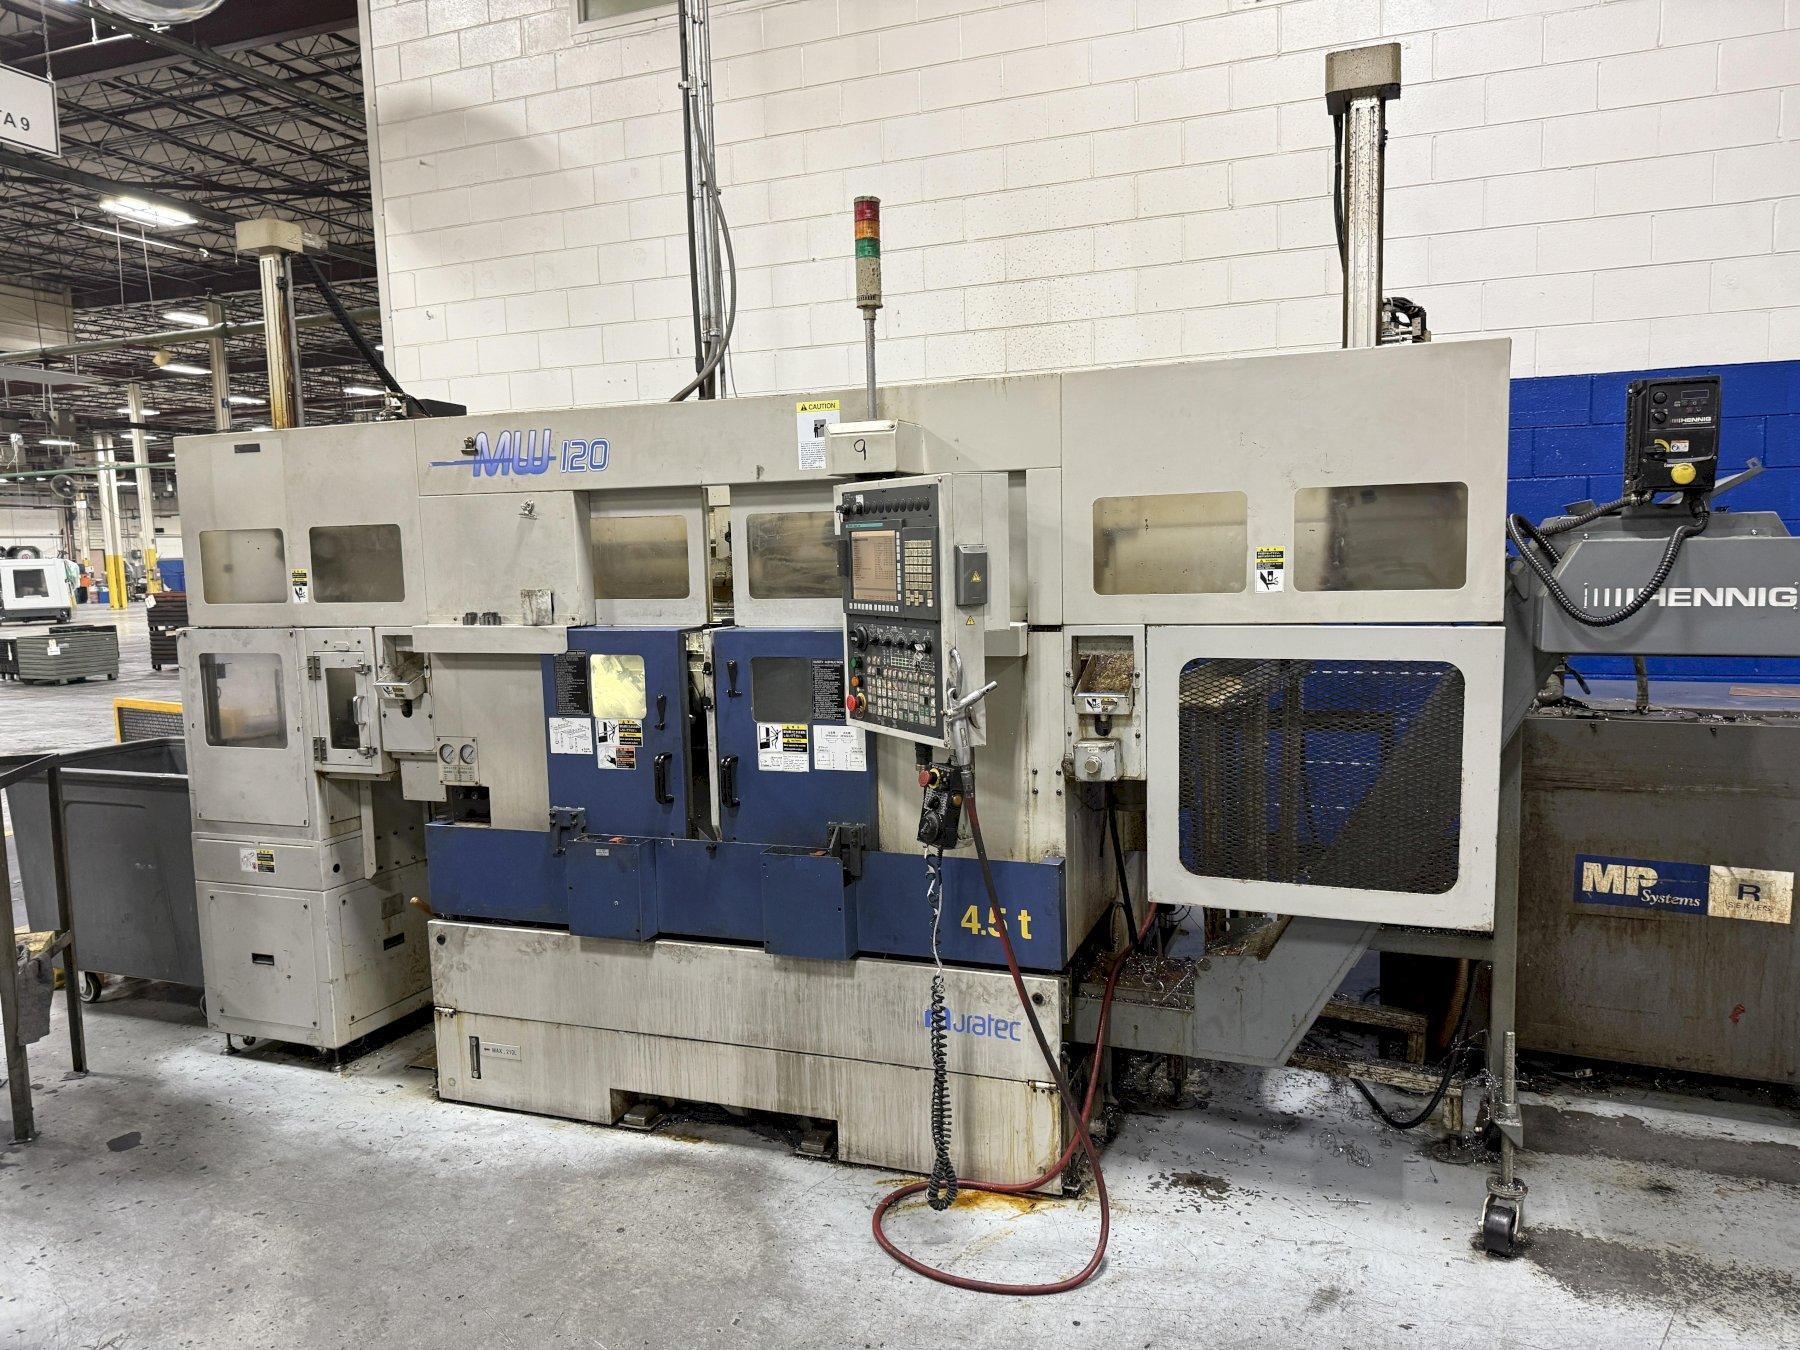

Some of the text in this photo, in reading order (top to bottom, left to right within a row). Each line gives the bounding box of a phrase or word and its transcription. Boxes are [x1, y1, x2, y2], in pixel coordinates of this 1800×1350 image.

[808, 402, 836, 411] CAUTION
[473, 429, 611, 477] MW 120
[853, 438, 867, 461] 9
[1581, 861, 1659, 897] MP
[1640, 889, 1701, 908] Systems
[1737, 883, 1762, 902] R
[1726, 901, 1772, 912] SERIES
[960, 904, 1033, 940] 4.5 t
